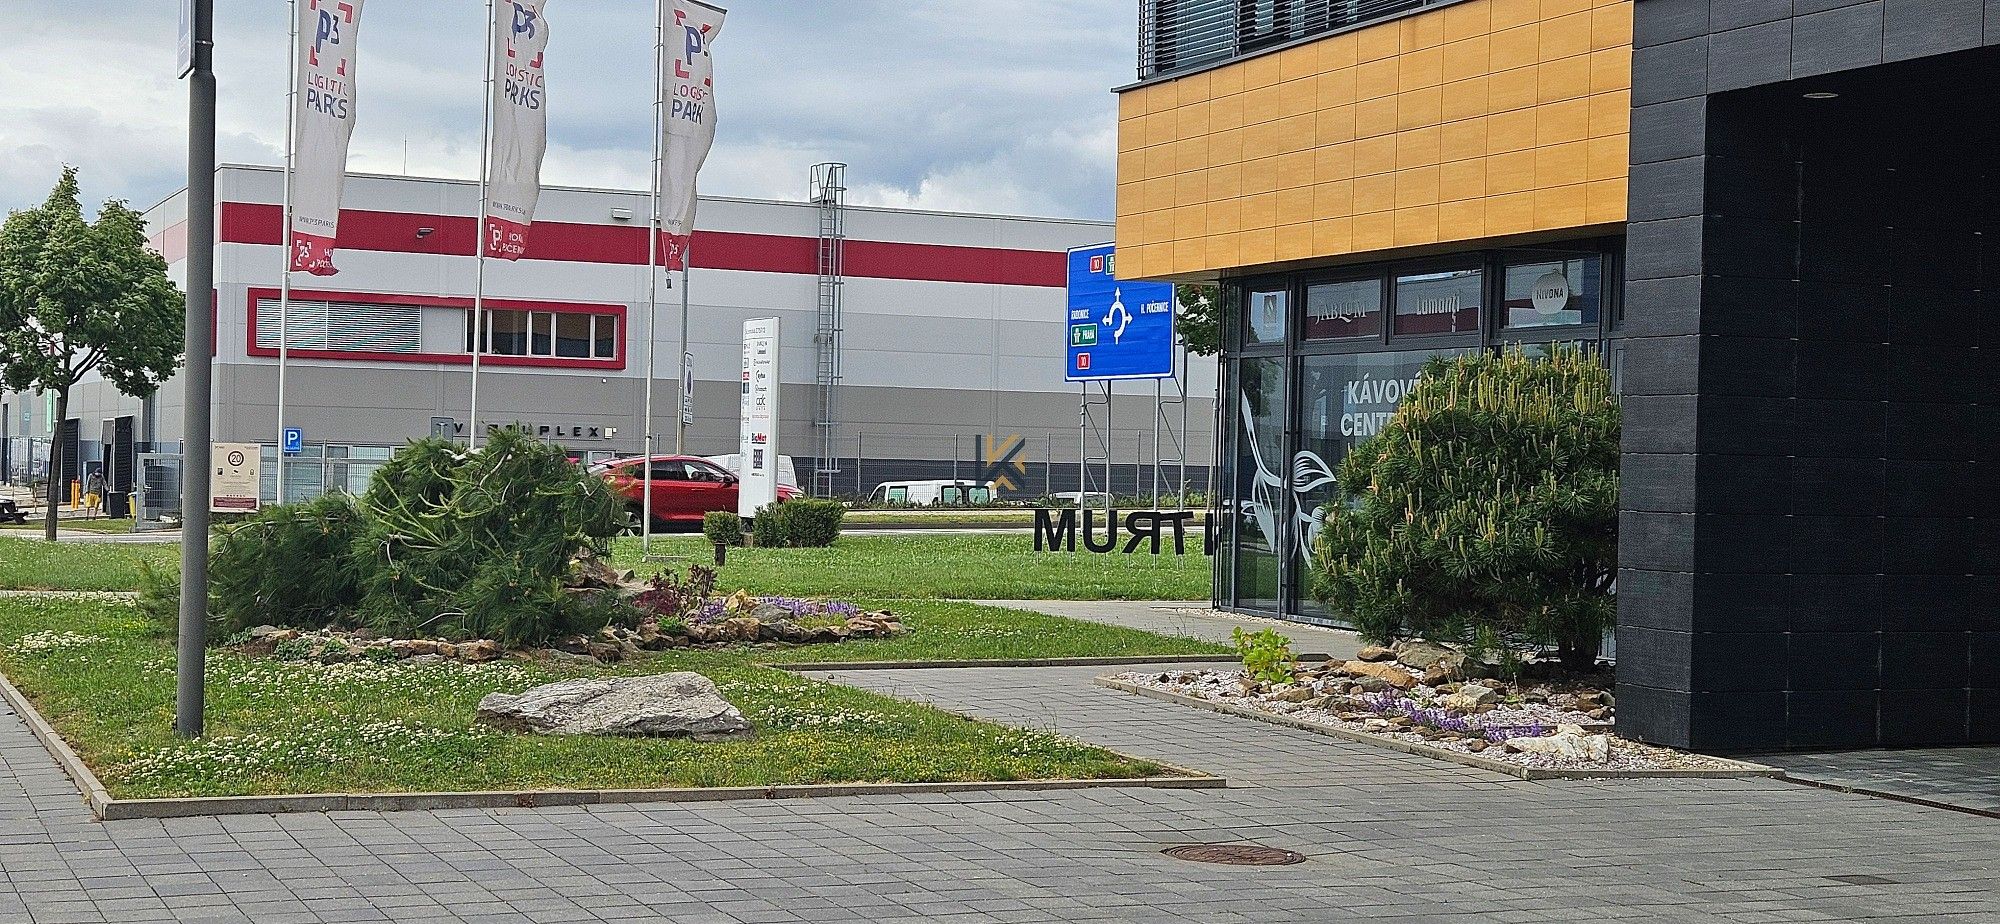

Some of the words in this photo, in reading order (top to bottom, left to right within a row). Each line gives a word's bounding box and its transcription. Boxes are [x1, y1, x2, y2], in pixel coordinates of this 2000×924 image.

[315, 8, 341, 54] P3
[306, 87, 348, 120] PARKS
[1094, 258, 1100, 270] 10
[1080, 356, 1087, 367] 10
[287, 431, 299, 446] P
[231, 454, 242, 463] 20
